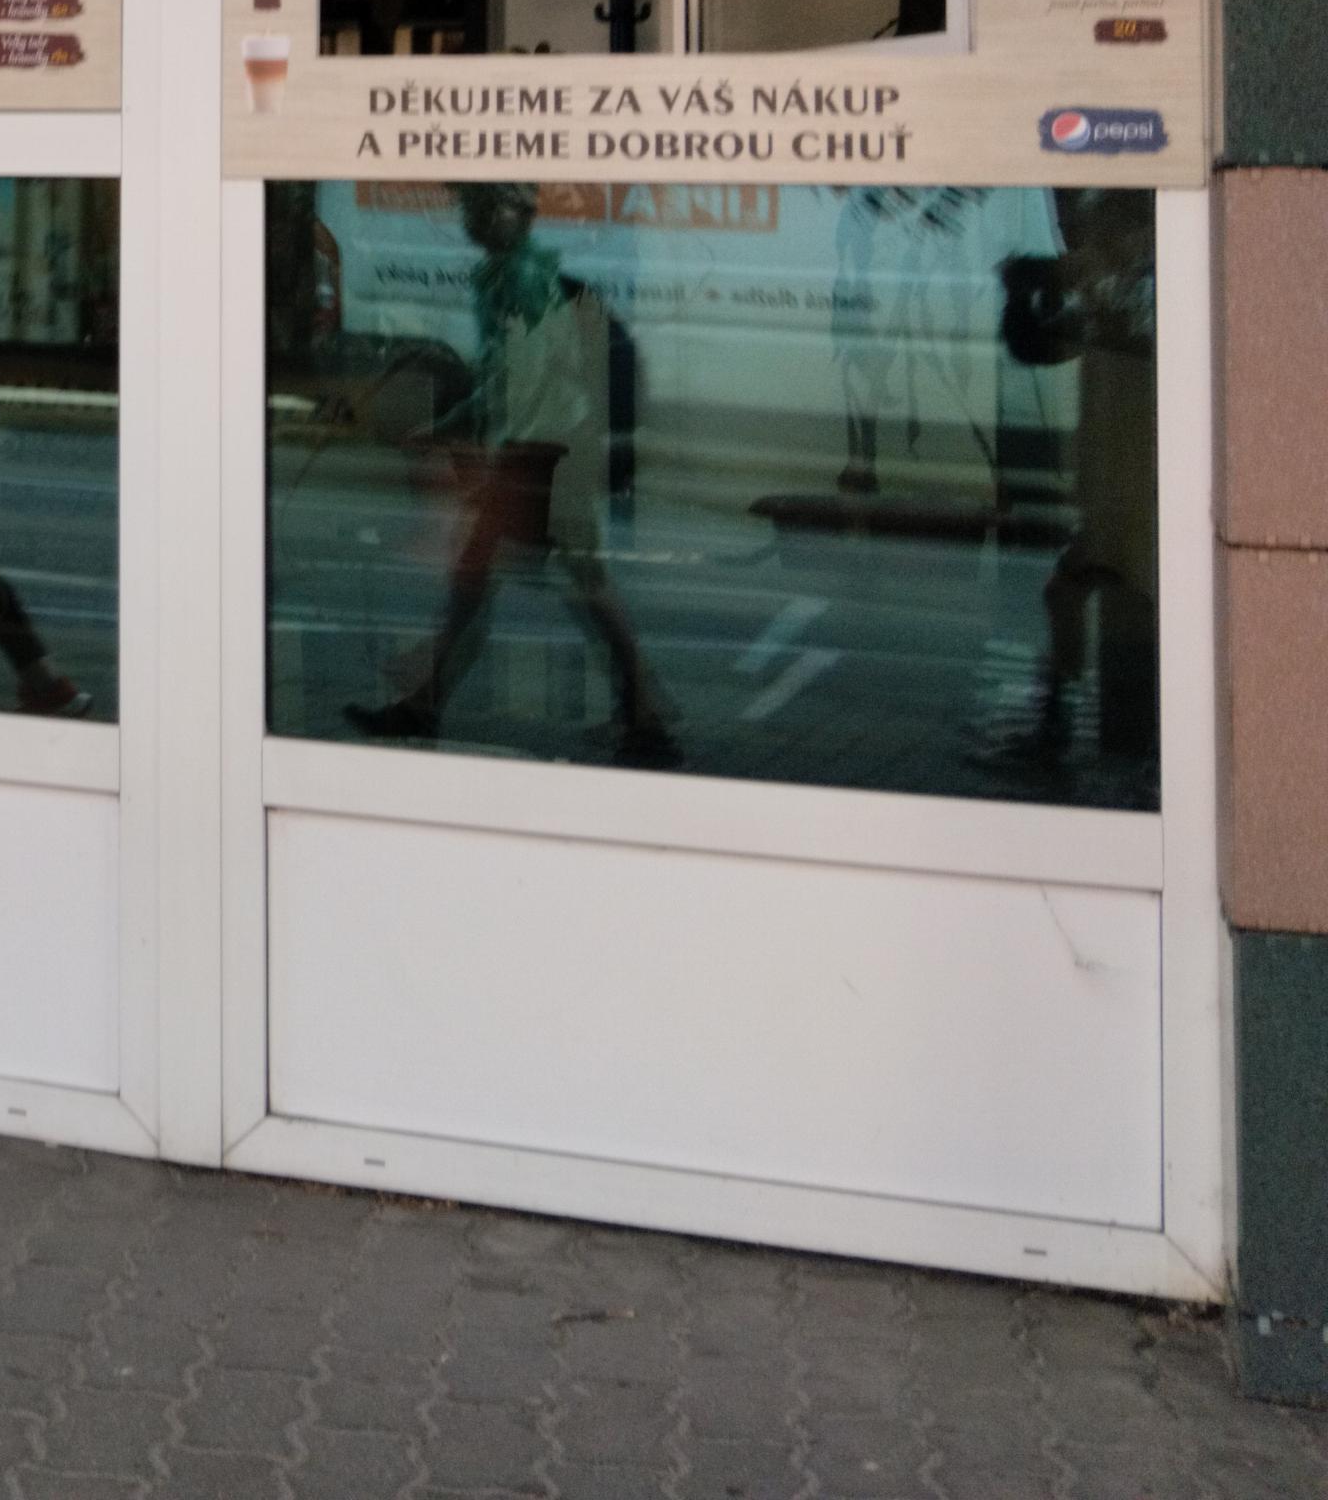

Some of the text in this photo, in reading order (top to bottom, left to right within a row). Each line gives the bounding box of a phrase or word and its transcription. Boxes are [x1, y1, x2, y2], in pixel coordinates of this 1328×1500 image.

[368, 78, 901, 116] DĚKUJEME ZA VÁŠ NÁKUP
[357, 122, 913, 162] A PŘEJEME DOBROU CHUŤ
[1094, 121, 1153, 142] pepsi
